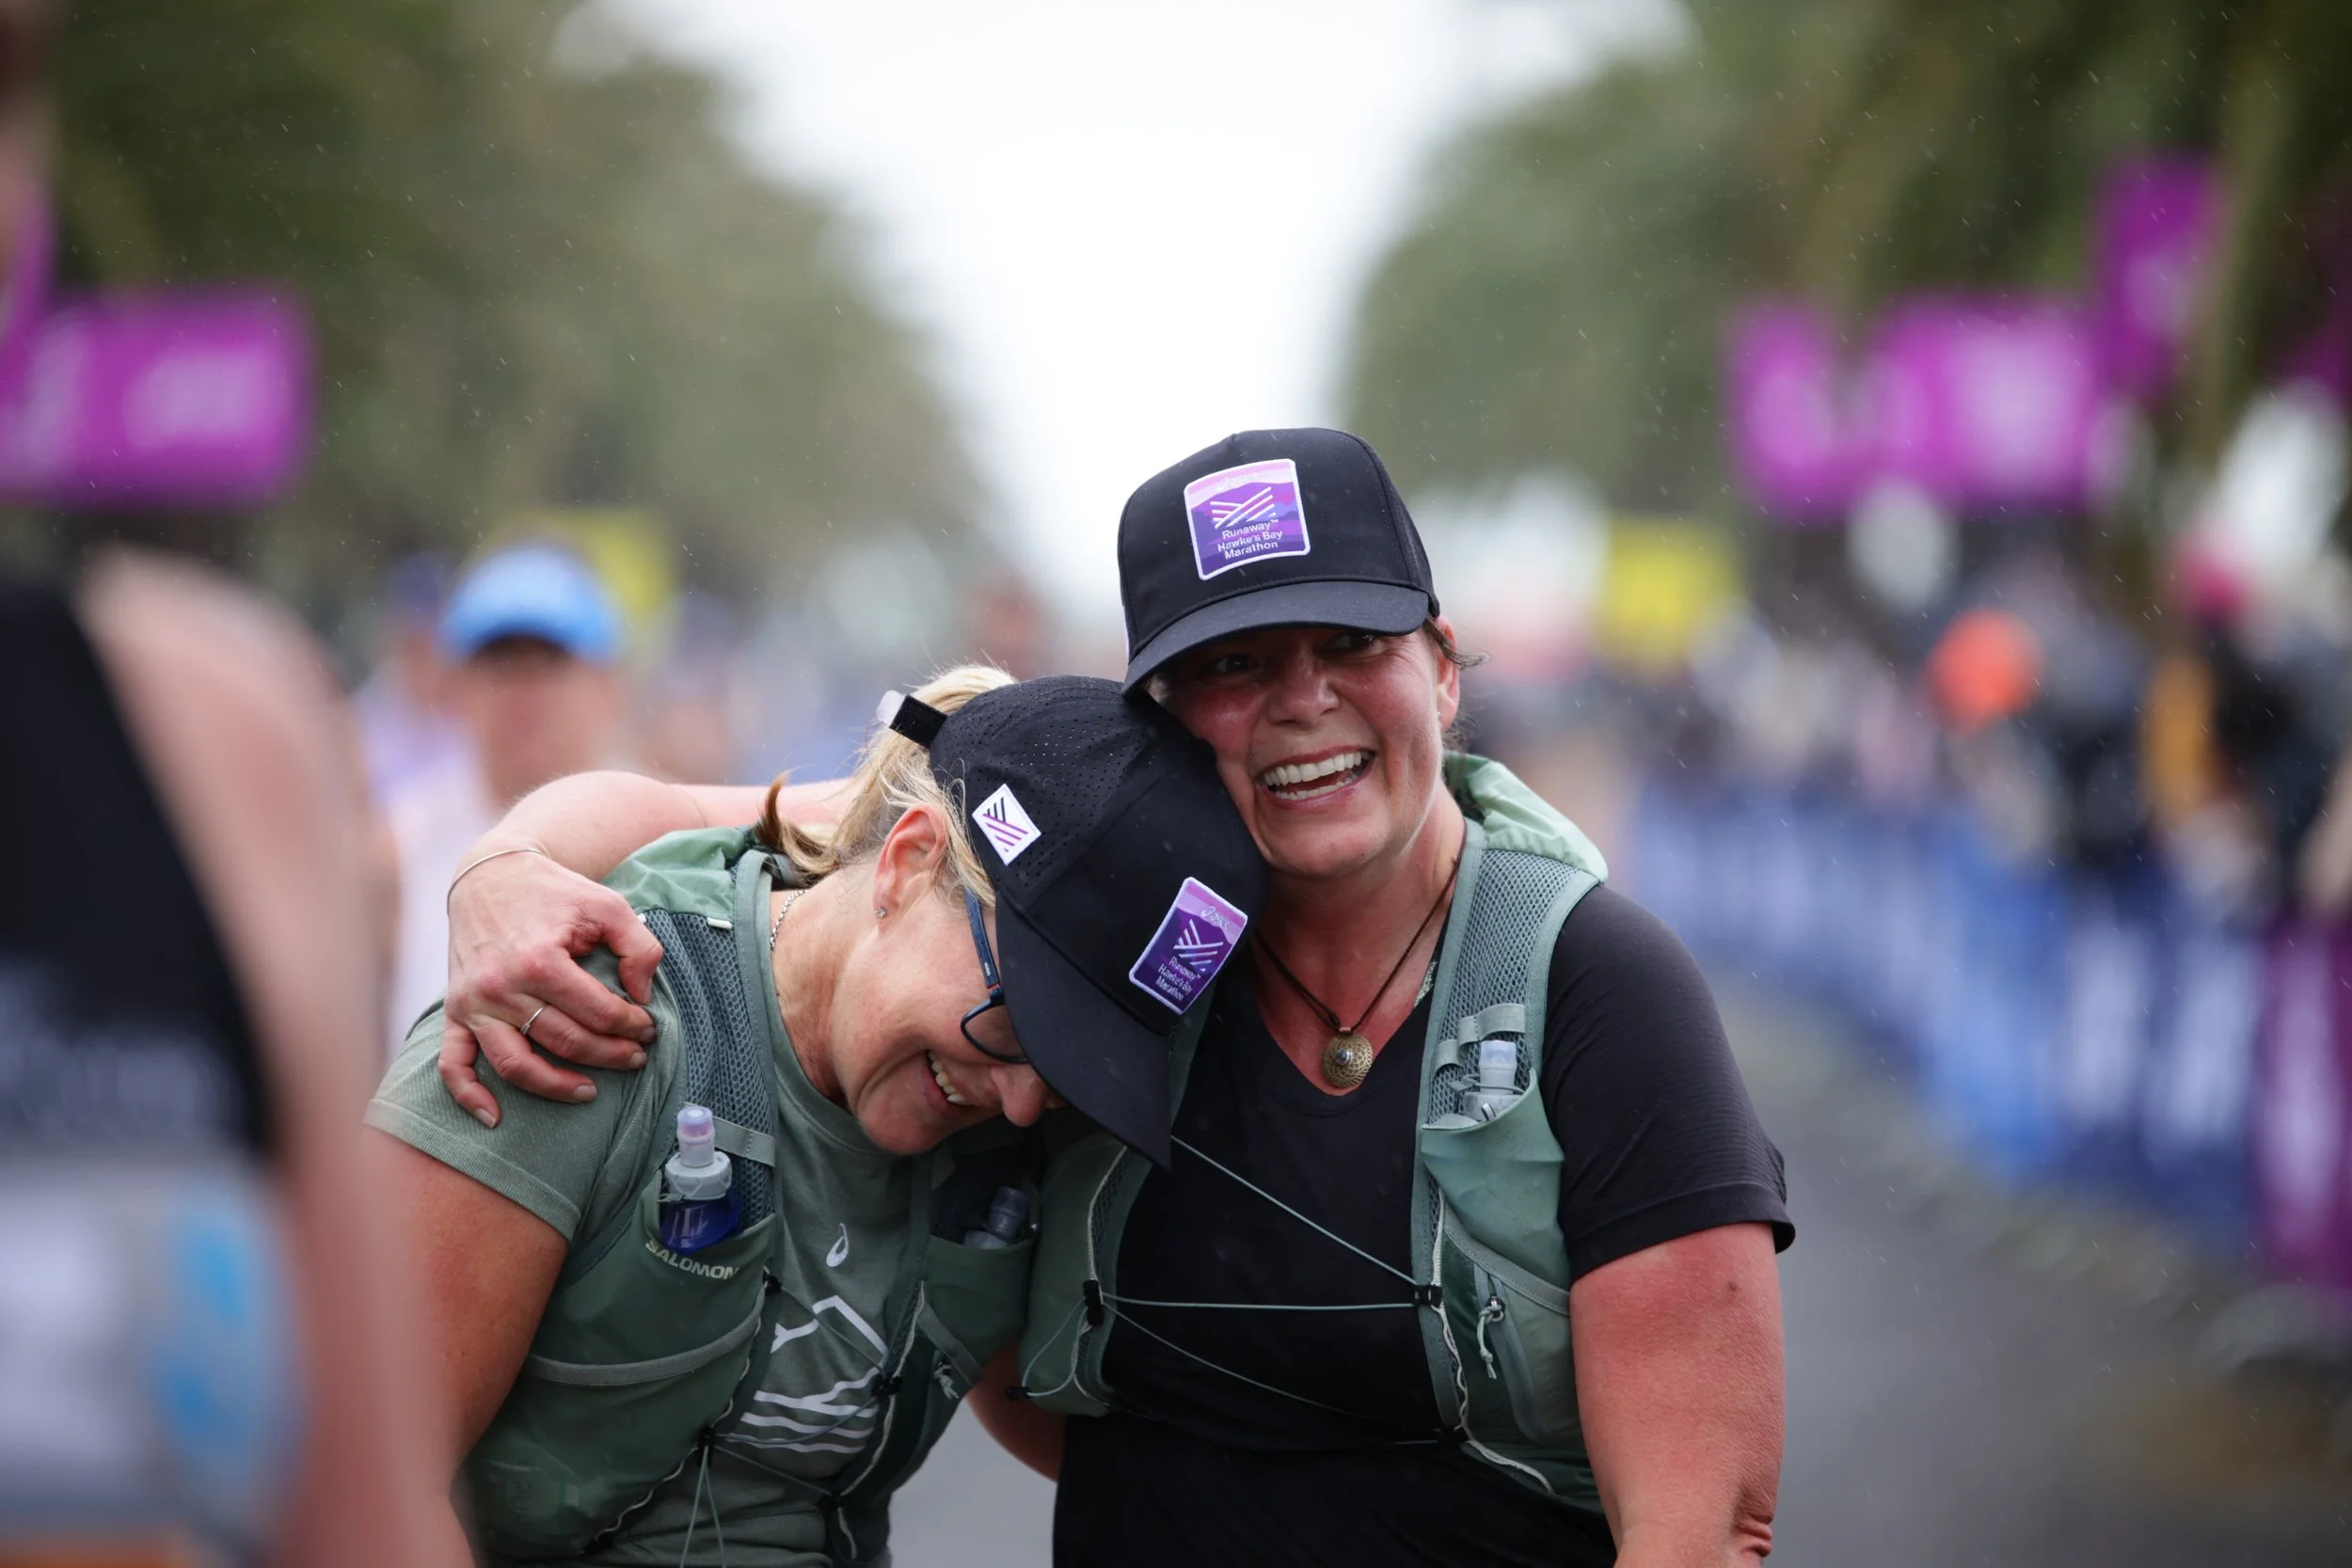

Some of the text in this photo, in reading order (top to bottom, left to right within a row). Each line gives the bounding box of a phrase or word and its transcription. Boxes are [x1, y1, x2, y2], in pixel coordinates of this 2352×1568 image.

[1217, 531, 1283, 552] Hawke's Bay
[1224, 542, 1279, 560] Marathon
[1155, 975, 1184, 1001] Marathon
[644, 1240, 739, 1279] SALOMON
